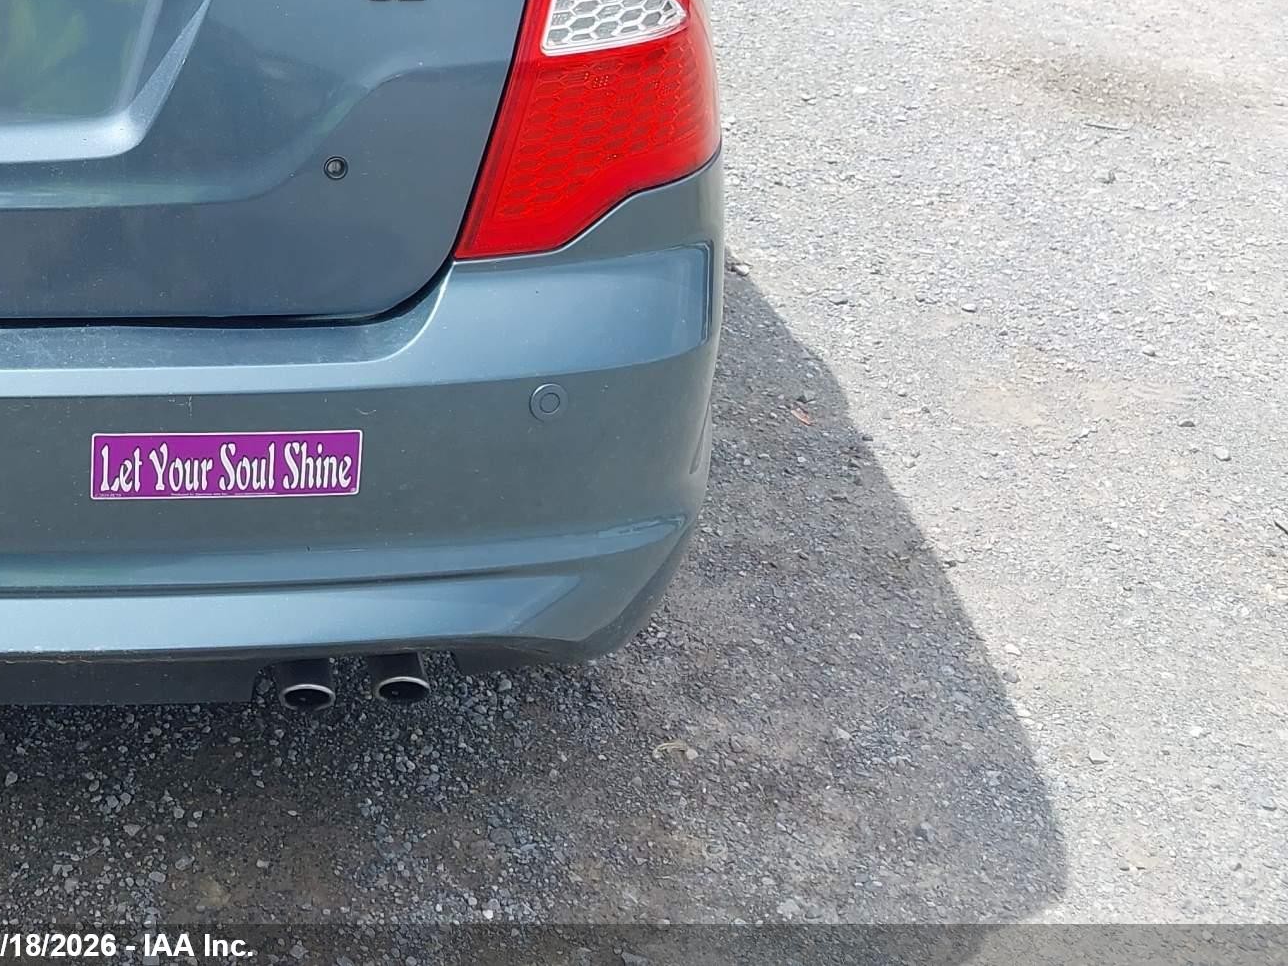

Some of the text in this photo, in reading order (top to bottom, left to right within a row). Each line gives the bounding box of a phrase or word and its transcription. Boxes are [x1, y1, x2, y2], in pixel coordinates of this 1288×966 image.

[100, 441, 352, 493] Let Your Soul Shine
